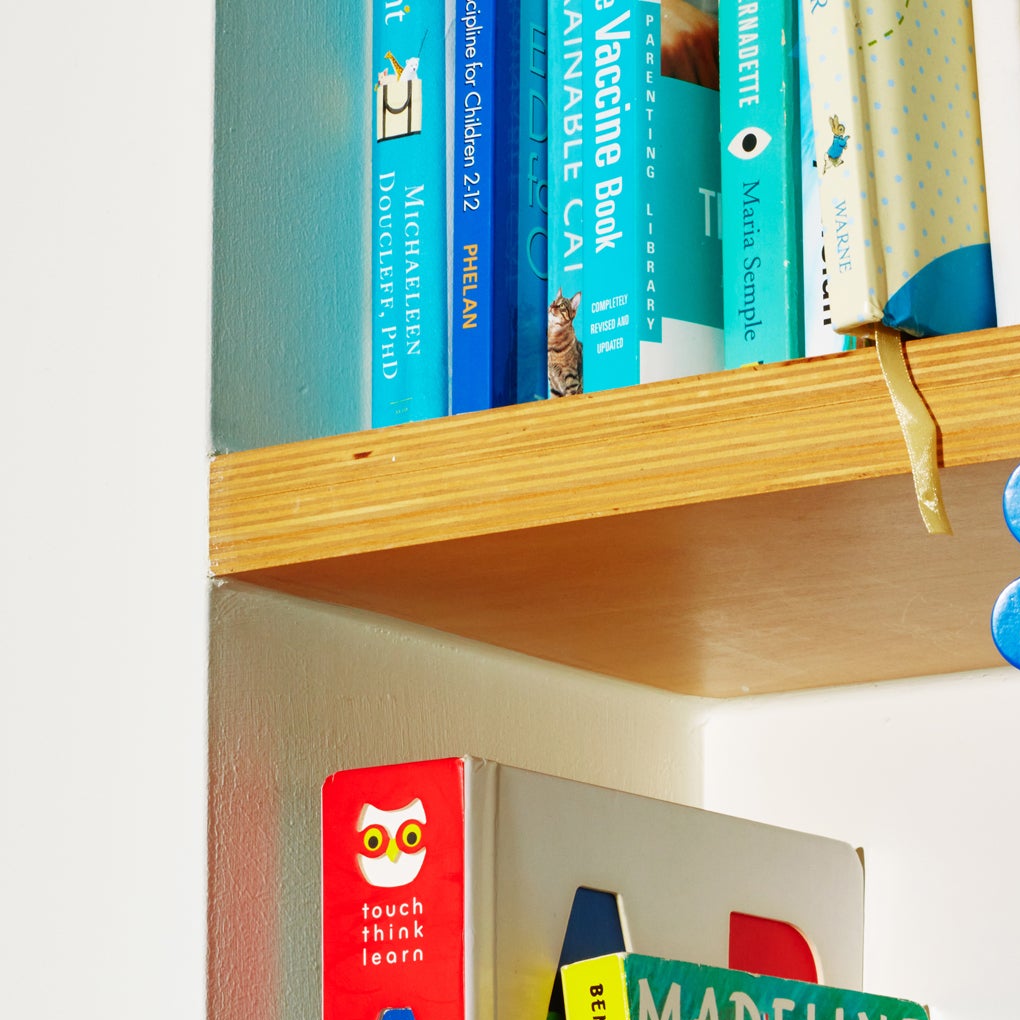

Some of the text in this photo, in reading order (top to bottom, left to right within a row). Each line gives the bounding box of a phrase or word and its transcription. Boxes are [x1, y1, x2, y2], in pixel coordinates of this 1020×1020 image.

[563, 0, 583, 181] AINABLE
[595, 9, 631, 168] Vaccine
[737, 0, 759, 108] RNADETTE
[461, 0, 484, 212] cipline for Children 2-12
[645, 14, 656, 331] PARENTING LIBRARY
[595, 176, 623, 254] Book
[834, 200, 852, 274] WARNE
[462, 244, 479, 329] PHELAN
[738, 181, 763, 342] Maria Semple
[590, 314, 630, 334] REVISED AND
[591, 294, 628, 313] COMPLETELY
[596, 337, 624, 354] UPDATED
[362, 897, 424, 920] touch
[362, 920, 424, 943] think
[362, 948, 424, 967] learn
